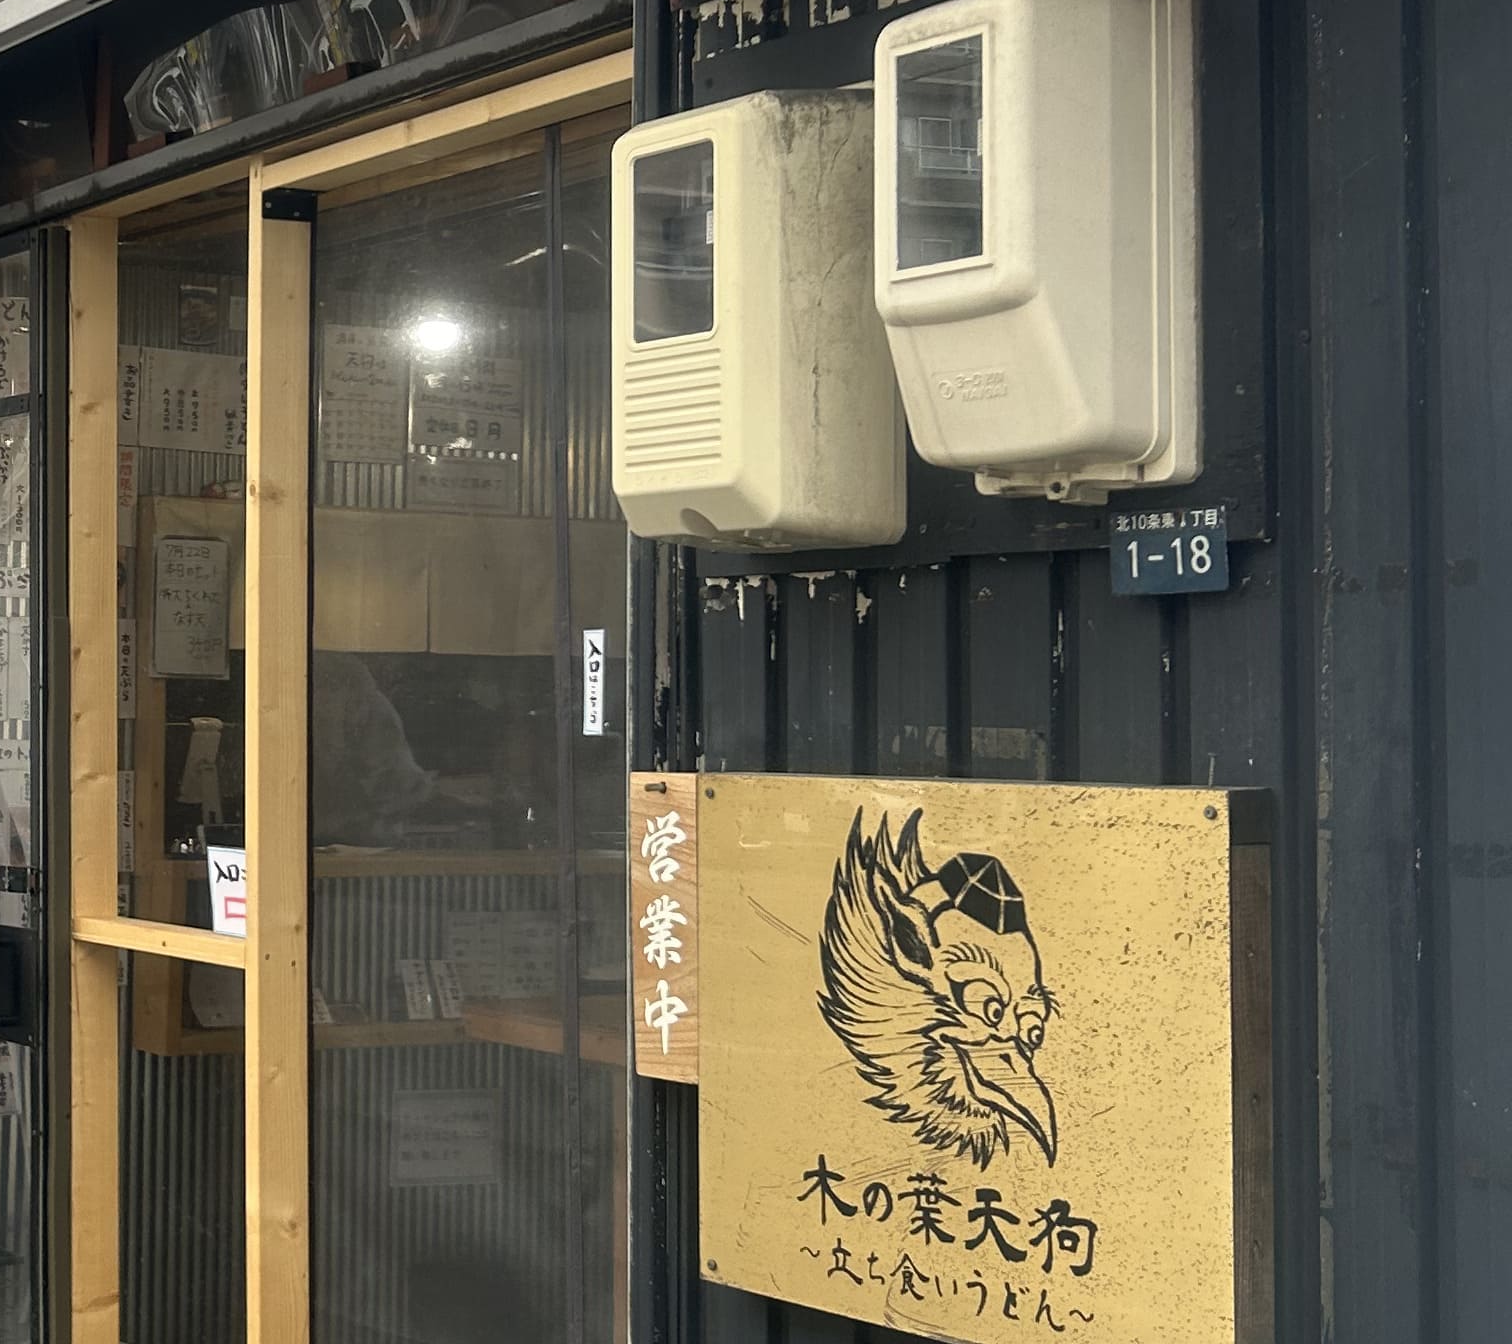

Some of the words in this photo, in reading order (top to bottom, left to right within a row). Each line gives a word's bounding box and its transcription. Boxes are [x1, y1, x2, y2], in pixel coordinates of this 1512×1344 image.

[1127, 535, 1212, 578] 1-18
[638, 810, 689, 1055] 営業中
[796, 1154, 1098, 1276] 木の葉天狗
